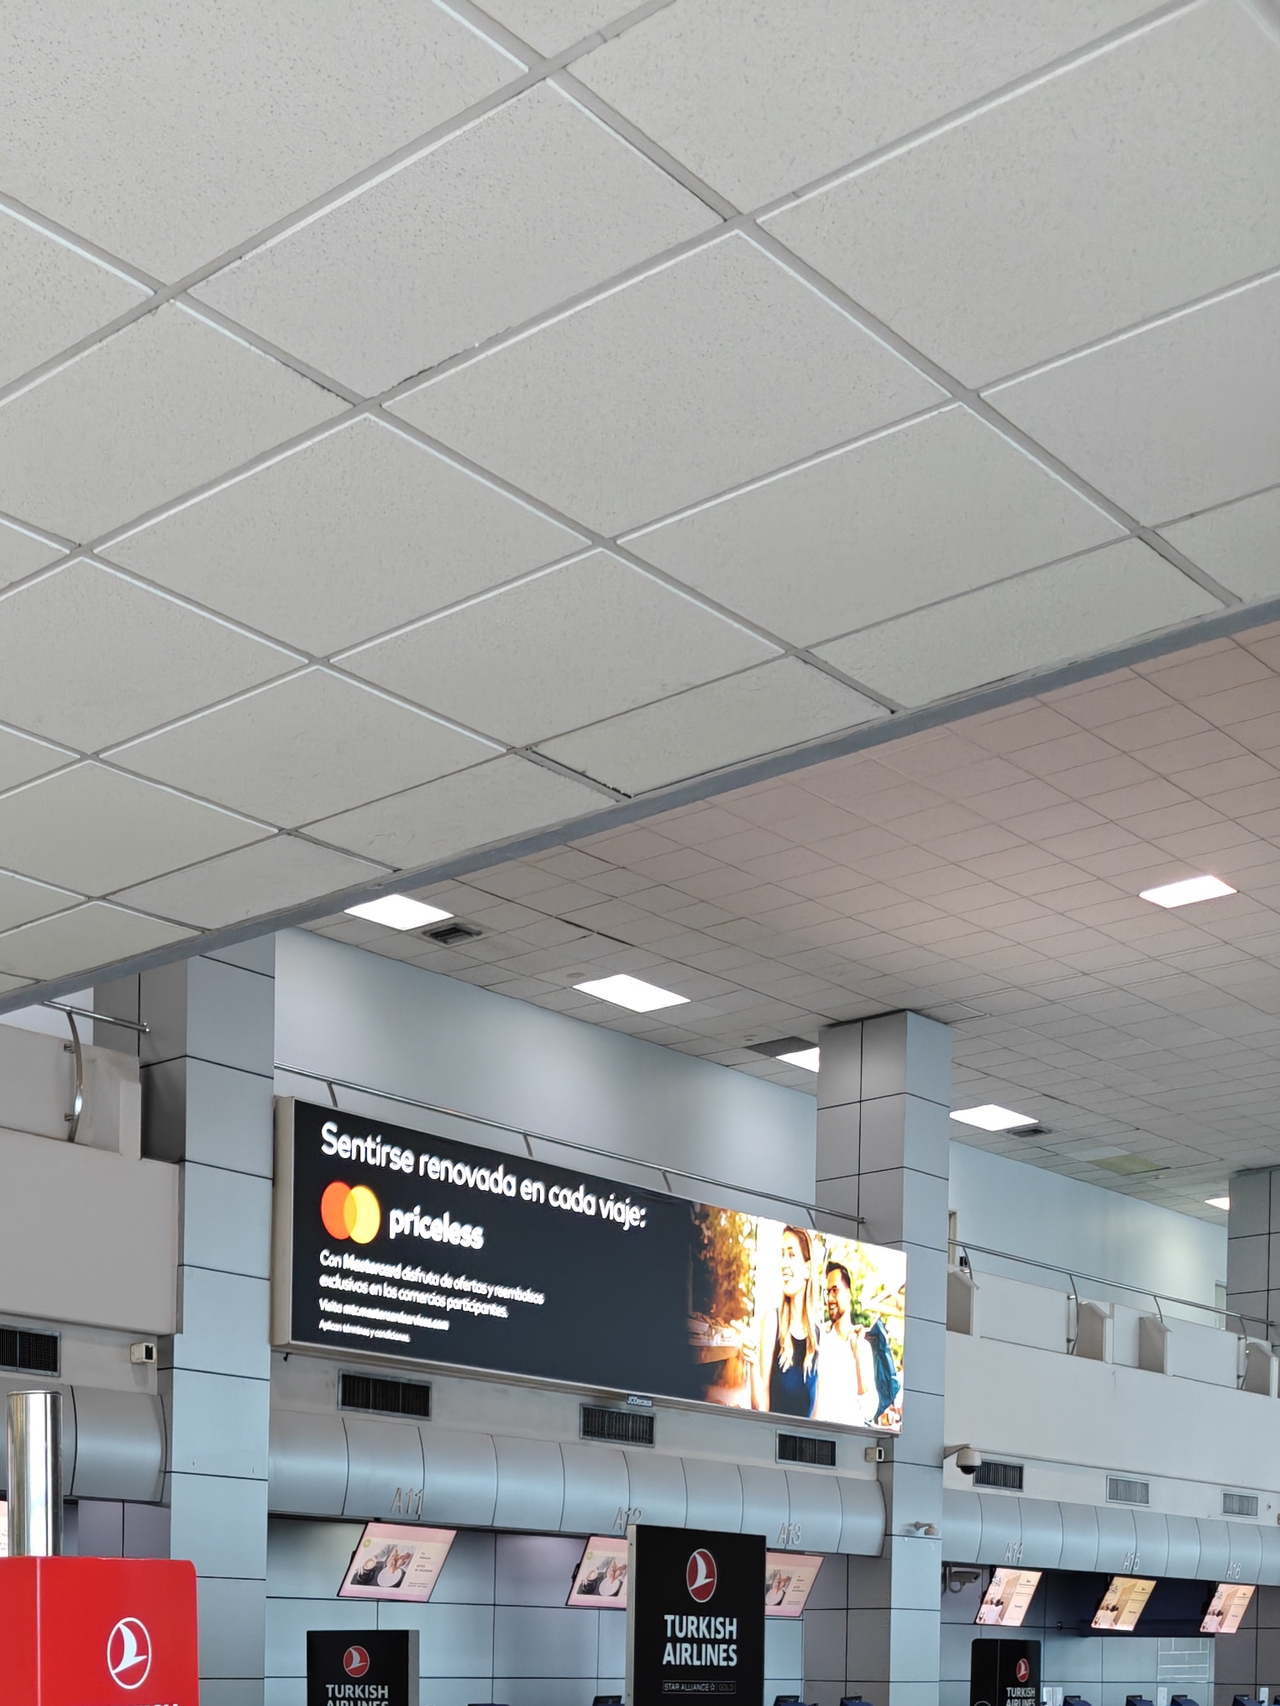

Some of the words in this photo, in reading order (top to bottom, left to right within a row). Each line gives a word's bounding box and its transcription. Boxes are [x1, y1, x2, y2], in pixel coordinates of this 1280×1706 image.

[321, 1121, 415, 1173] Sentirse
[419, 1153, 517, 1198] renovada
[520, 1178, 545, 1204] en
[549, 1184, 597, 1216] cada
[599, 1193, 647, 1231] viaje:
[389, 1205, 484, 1250] priceless
[320, 1249, 342, 1268] Con
[402, 1264, 440, 1286] disfruta
[440, 1272, 453, 1288] de
[453, 1274, 487, 1295] ofertas
[487, 1284, 495, 1299] y
[319, 1273, 369, 1294] exclusivos
[369, 1282, 382, 1297] en
[383, 1281, 398, 1299] los
[398, 1287, 446, 1308] comercios
[389, 1487, 424, 1515] A11
[777, 1522, 802, 1545] A13
[664, 1614, 737, 1640] TURKISH
[662, 1642, 737, 1667] AIRLINES
[326, 1684, 389, 1699] TURKISH
[664, 1683, 680, 1691] STAR
[681, 1683, 709, 1691] ALLIANCE
[1006, 1687, 1035, 1698] TURKISH
